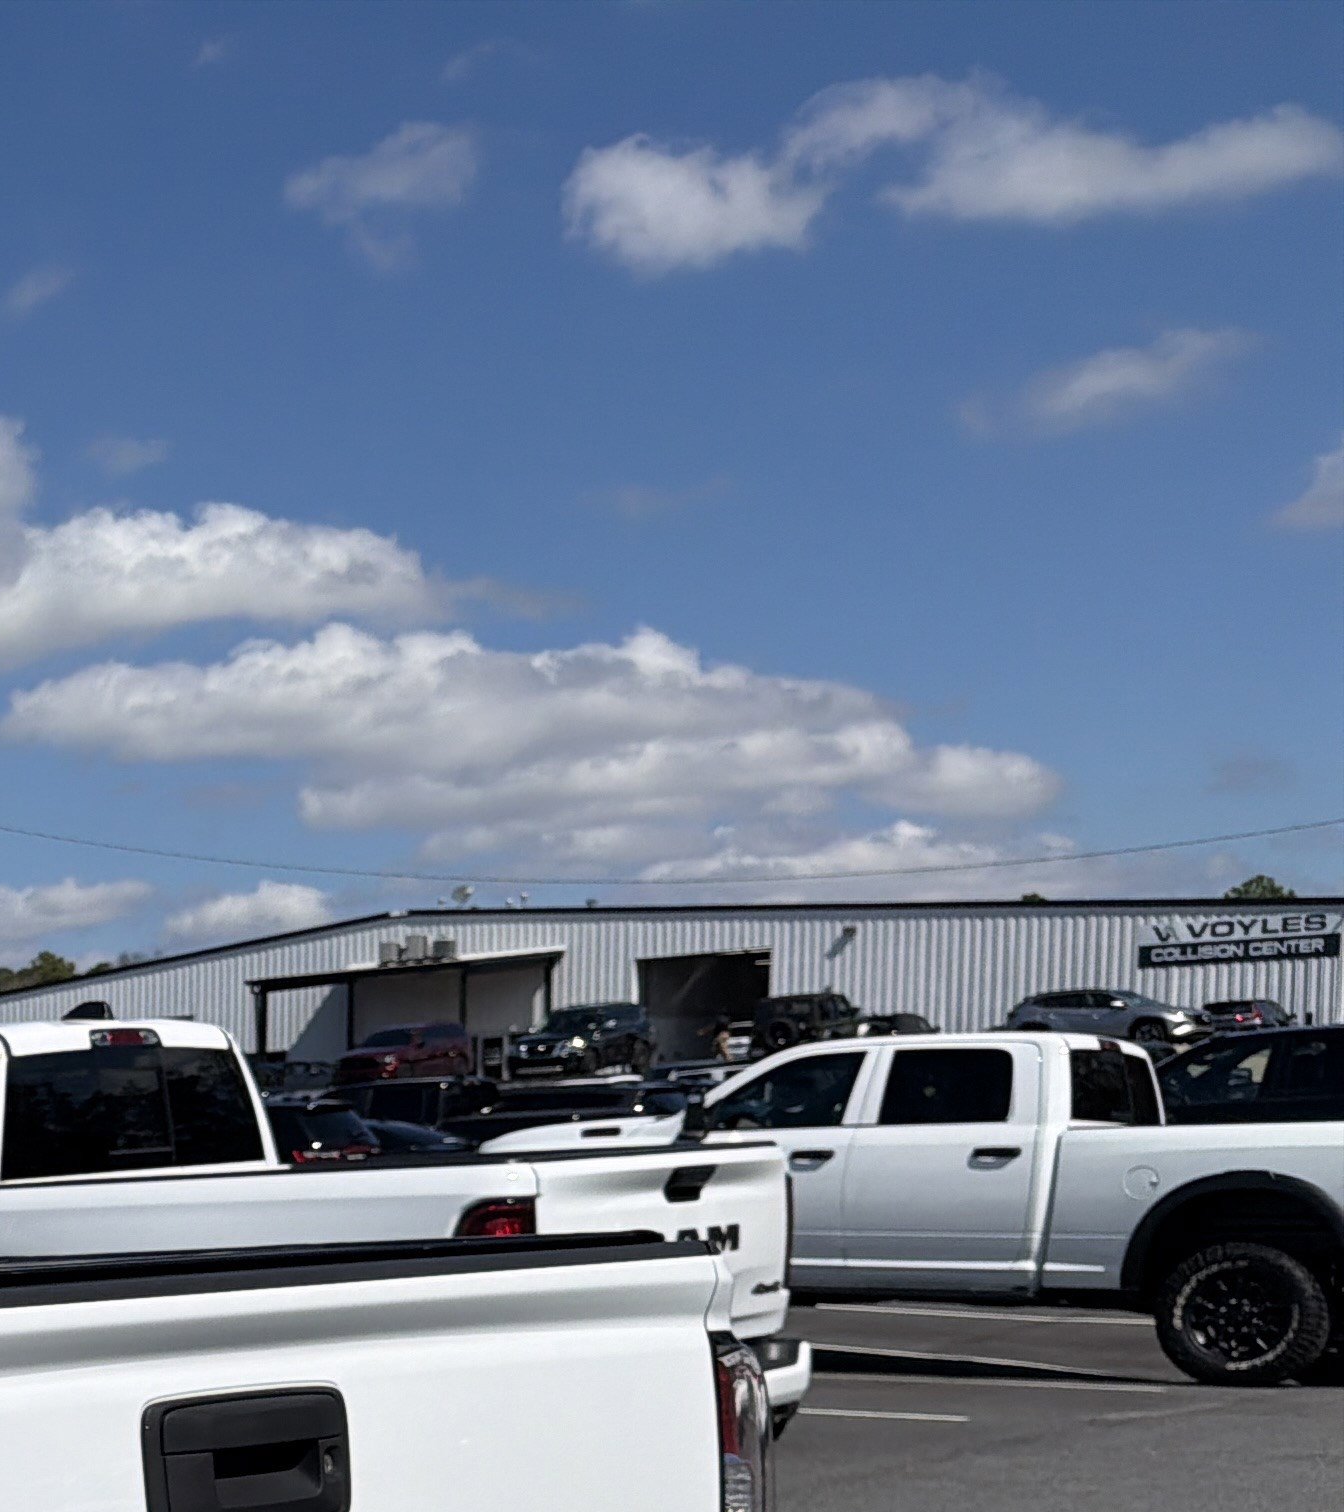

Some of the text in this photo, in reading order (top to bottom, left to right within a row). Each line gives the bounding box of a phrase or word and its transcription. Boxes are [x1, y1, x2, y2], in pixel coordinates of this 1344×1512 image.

[1186, 914, 1327, 938] VOYLES
[1150, 938, 1325, 963] COLLISION CENTER
